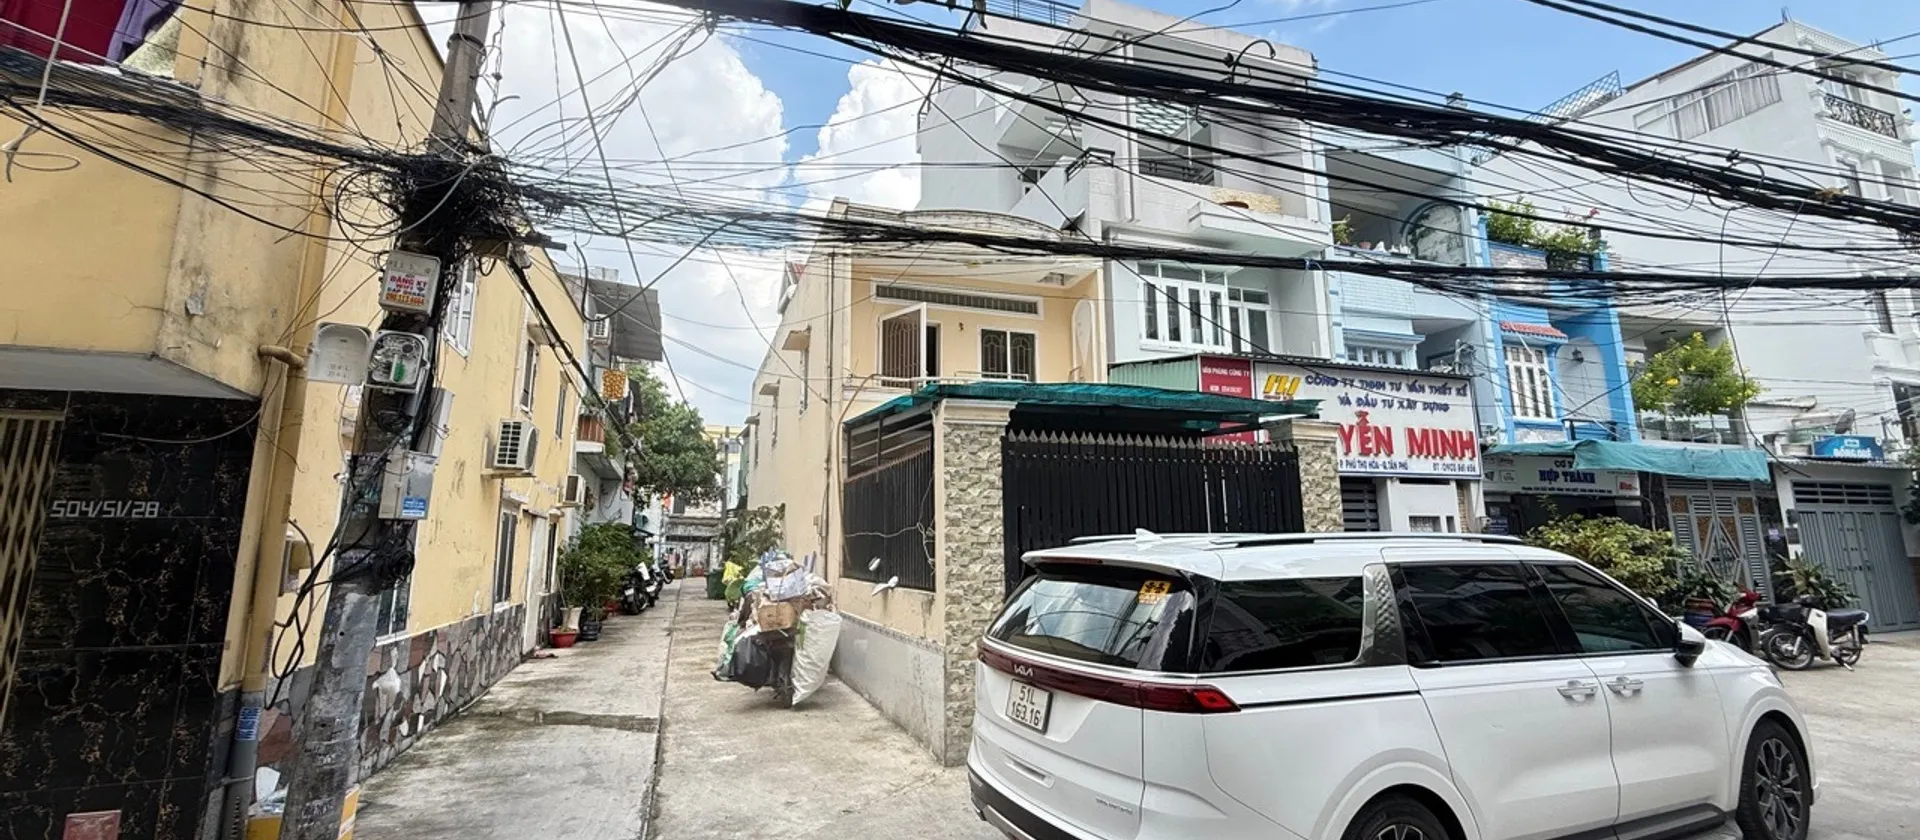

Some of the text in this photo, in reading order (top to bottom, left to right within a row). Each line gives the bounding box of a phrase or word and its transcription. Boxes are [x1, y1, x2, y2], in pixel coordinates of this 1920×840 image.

[1405, 427, 1476, 460] MINH
[49, 499, 160, 518] 504/51/28
[1013, 664, 1034, 677] KIA
[1018, 685, 1036, 706] 51L
[1012, 701, 1041, 726] 163.16
